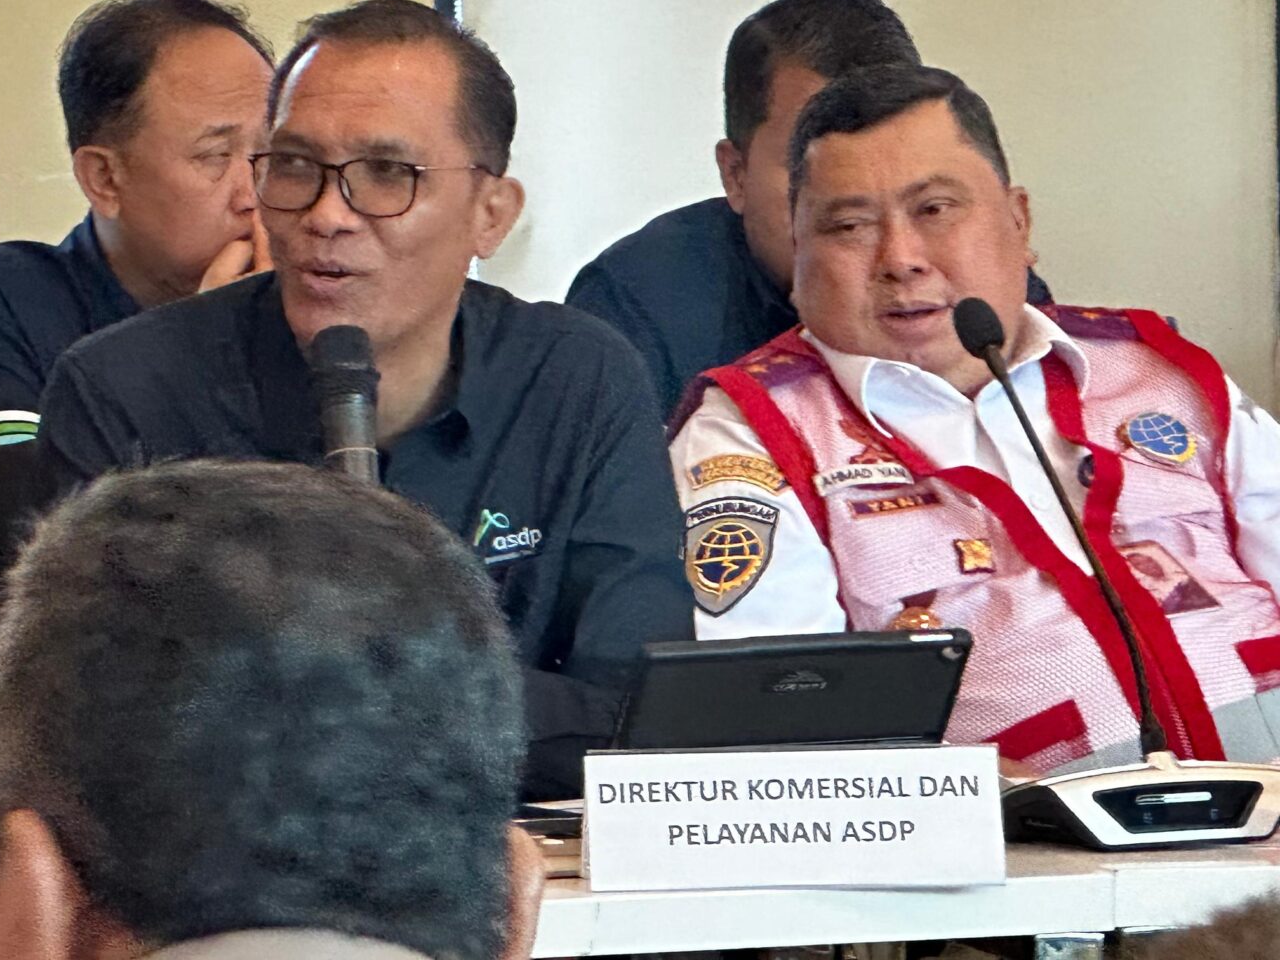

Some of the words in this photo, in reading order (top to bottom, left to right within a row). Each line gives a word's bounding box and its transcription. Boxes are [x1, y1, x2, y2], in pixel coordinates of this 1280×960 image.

[822, 467, 873, 486] AHMAD
[493, 527, 542, 550] asdp
[598, 780, 738, 804] DIREKTUR
[747, 776, 911, 801] KOMERSIAL
[919, 775, 980, 797] DAN
[668, 822, 832, 846] PELAYANAN
[841, 820, 915, 842] ASDP
